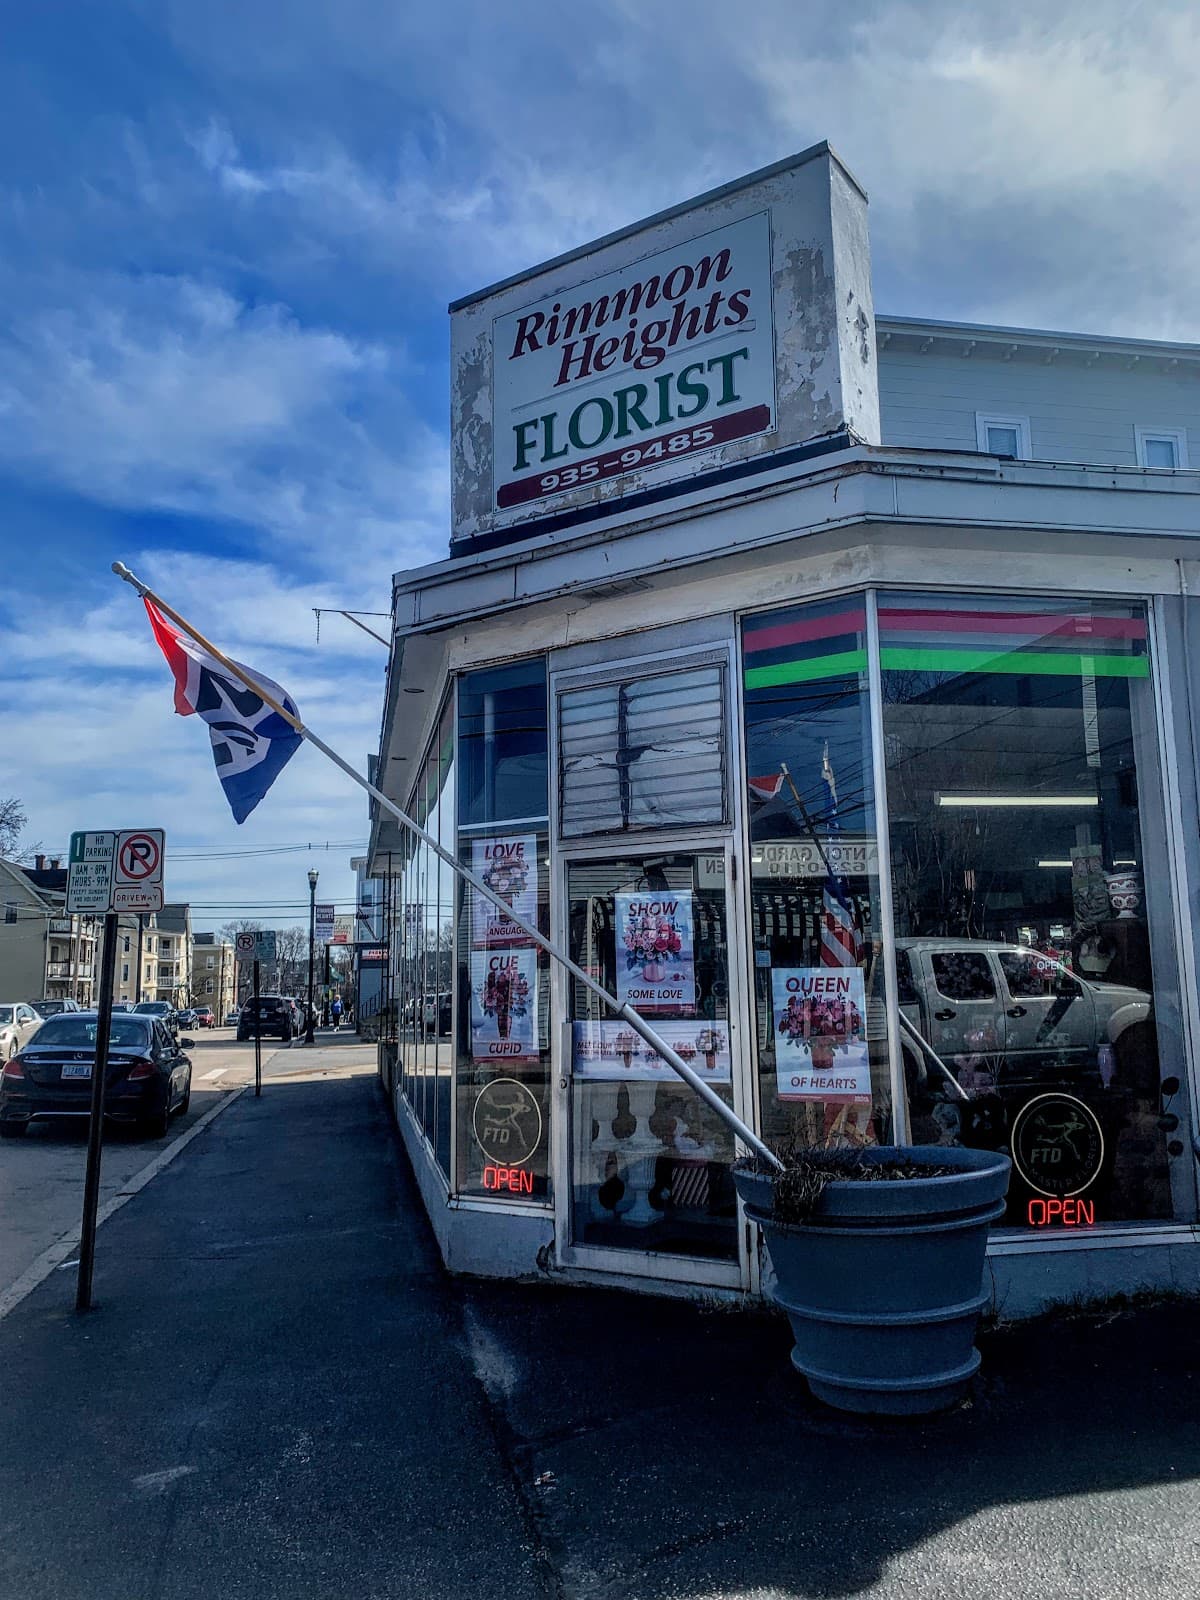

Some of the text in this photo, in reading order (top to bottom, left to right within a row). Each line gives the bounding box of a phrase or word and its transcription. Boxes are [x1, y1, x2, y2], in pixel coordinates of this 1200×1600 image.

[509, 248, 733, 361] Rimmon
[553, 288, 751, 388] Heights
[512, 346, 749, 472] FLORIST
[540, 425, 715, 492] 935-9485
[76, 837, 81, 857] 1
[95, 835, 104, 845] HR
[85, 847, 112, 857] PARKING
[485, 842, 525, 860] LOVE
[75, 865, 88, 875] 8AM
[94, 864, 107, 874] 8PM
[72, 876, 90, 887] THURS
[96, 876, 109, 887] 9PM
[628, 901, 679, 917] SHOW
[489, 955, 519, 971] CUE
[785, 976, 850, 993] QUEEN
[627, 989, 683, 999] SOME LOVE
[489, 1041, 522, 1055] CUPID
[790, 1075, 857, 1090] OF HEARTS
[482, 1127, 510, 1144] FTD
[1031, 1147, 1062, 1164] FTD
[483, 1165, 534, 1194] OPEN
[1028, 1199, 1094, 1225] OPEN
